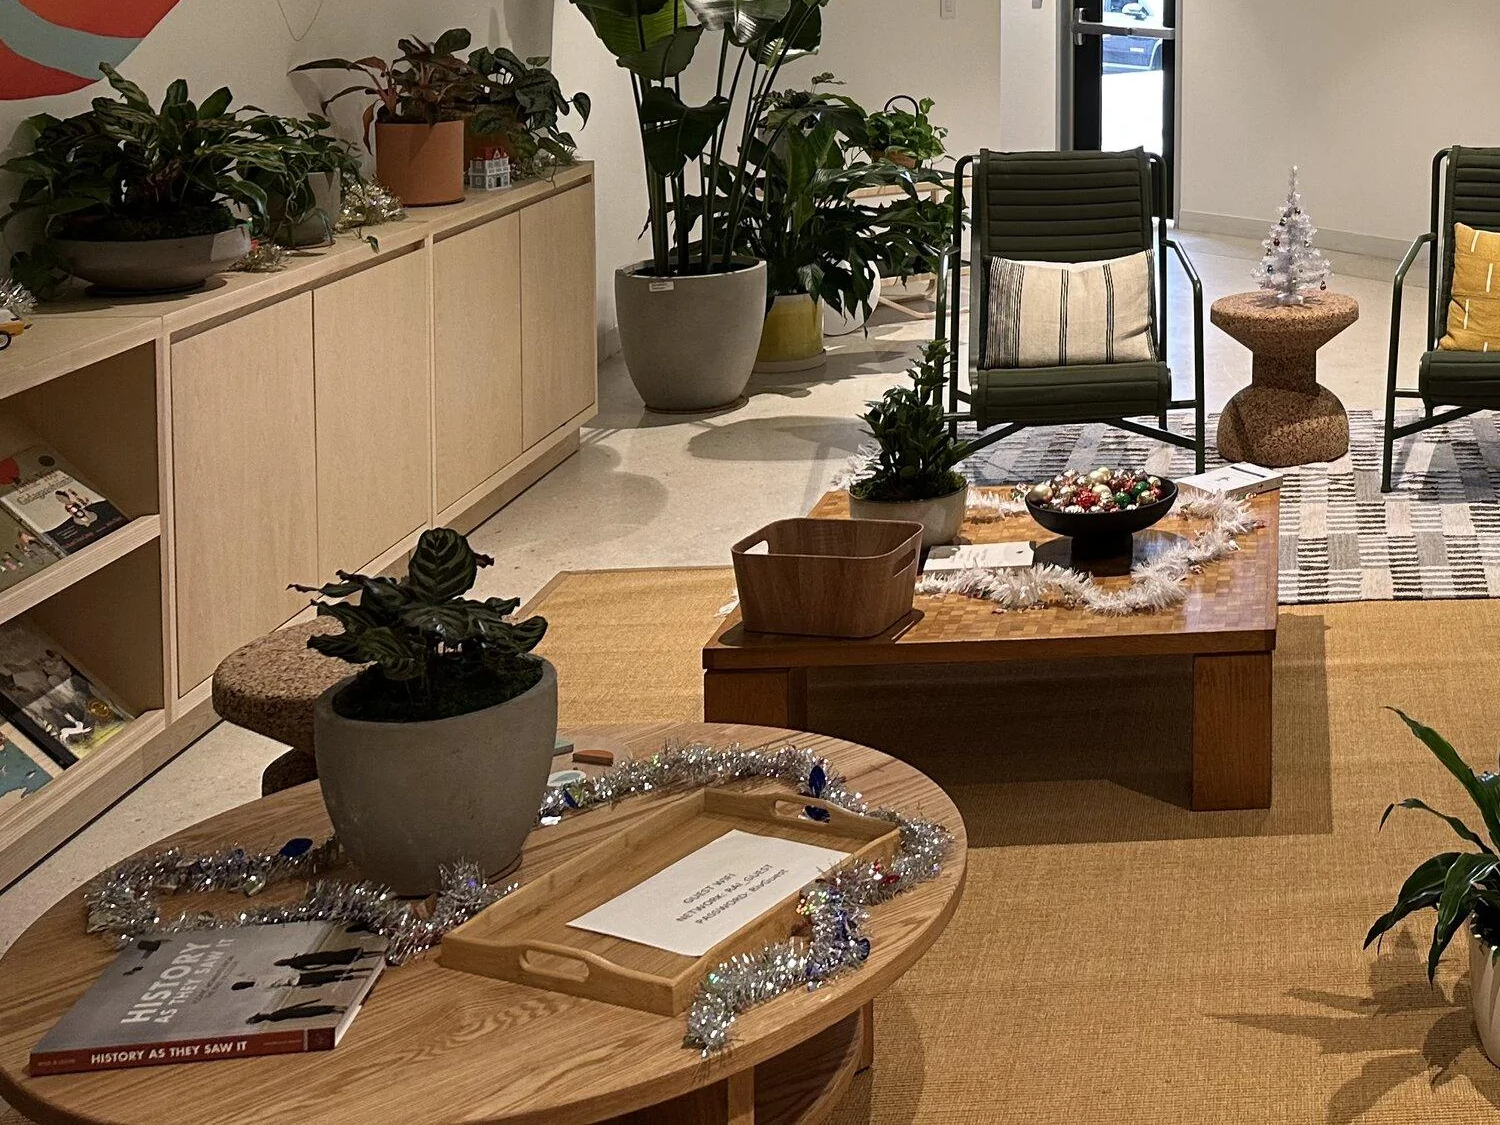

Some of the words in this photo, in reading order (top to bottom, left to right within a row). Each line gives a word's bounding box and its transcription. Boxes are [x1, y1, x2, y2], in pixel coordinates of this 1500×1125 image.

[683, 885, 715, 904] GUEST
[120, 942, 211, 1024] HISTORY
[153, 1008, 178, 1023] AS
[168, 978, 202, 1005] THEY
[193, 950, 225, 975] SAW
[215, 938, 237, 948] IT
[91, 1050, 145, 1064] HISTORY
[148, 1048, 166, 1060] AS
[169, 1045, 199, 1058] THEY
[204, 1042, 232, 1055] SAW
[236, 1040, 248, 1052] IT
